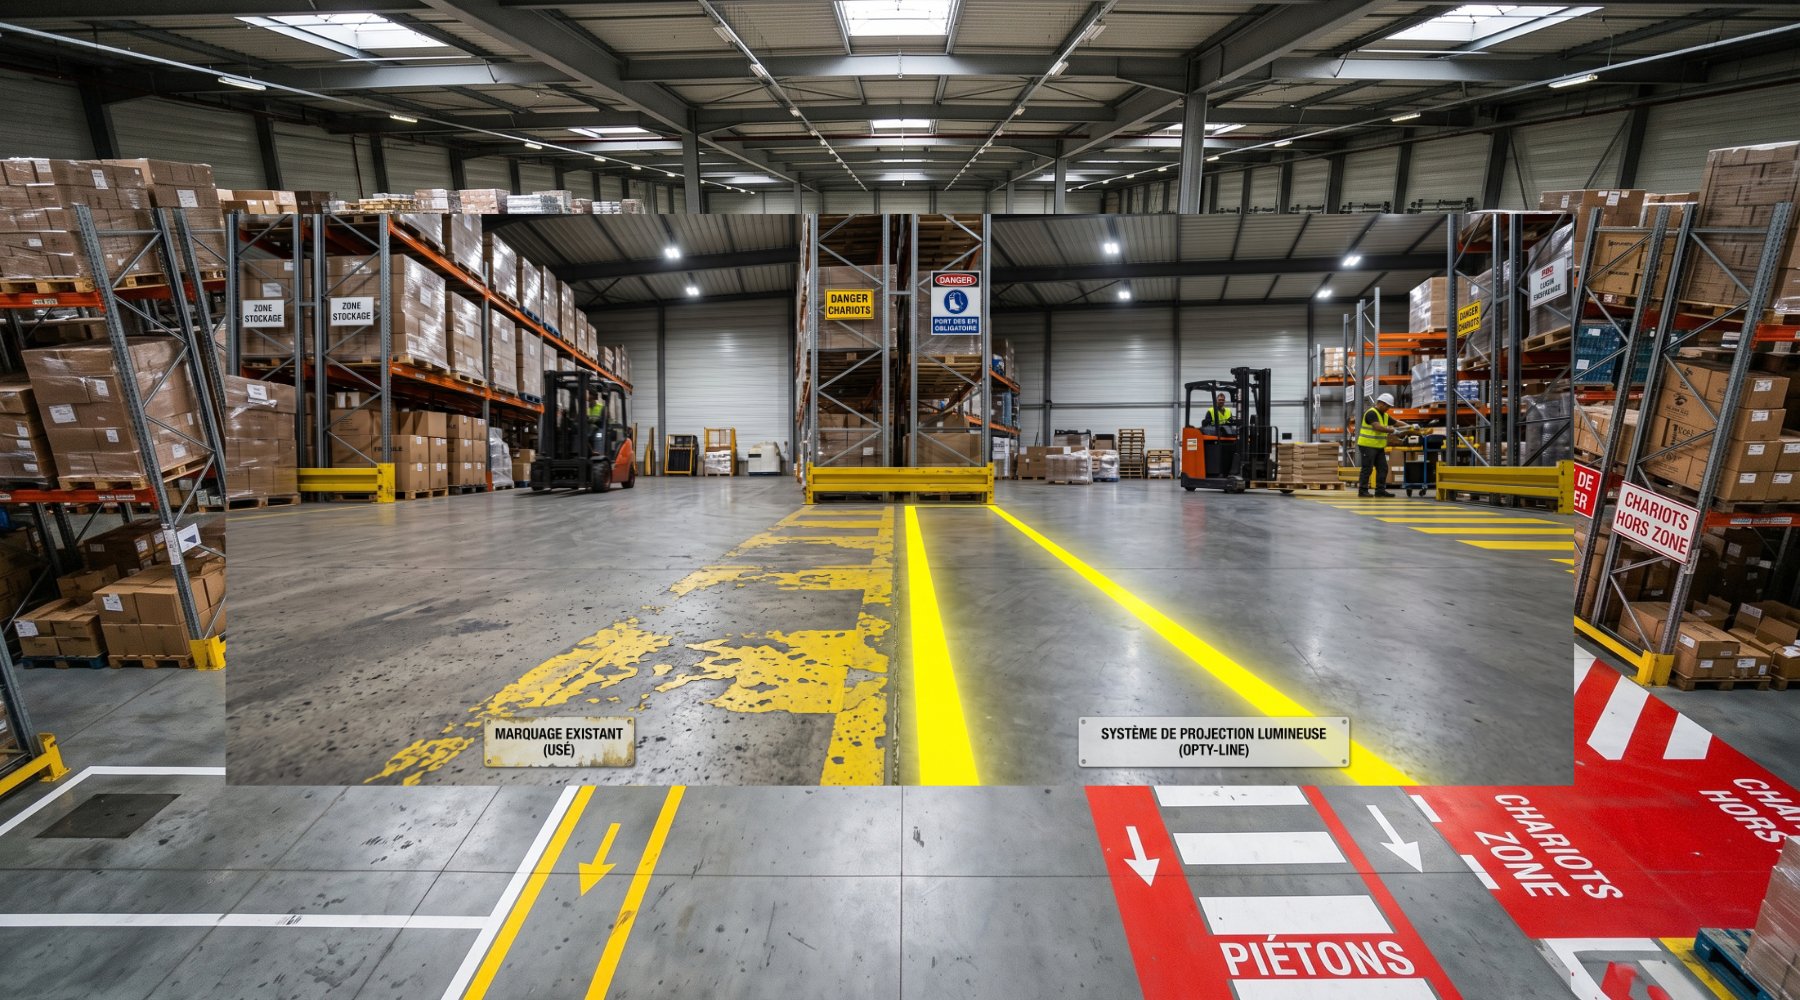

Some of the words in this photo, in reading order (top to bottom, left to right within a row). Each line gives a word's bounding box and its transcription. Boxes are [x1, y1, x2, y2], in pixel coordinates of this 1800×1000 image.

[939, 276, 973, 284] DANGER
[342, 302, 361, 310] ZONE
[831, 294, 868, 303] DANGER
[254, 304, 273, 312] ZONE
[828, 305, 871, 315] CHARIOTS
[244, 314, 282, 323] STOCKAGE
[332, 312, 371, 321] STOCKAGE
[1577, 471, 1594, 491] DE
[1625, 491, 1689, 531] CHARIOTS
[1616, 510, 1649, 537] HORS
[1652, 525, 1689, 555] ZONE
[495, 727, 562, 740] MARQUAGE
[566, 727, 623, 740] EXISTANT
[1101, 725, 1157, 740] SYSTÈME
[1161, 728, 1176, 740] DE
[1180, 727, 1254, 740] PROJECTION
[1258, 727, 1327, 740] LUMINEUSE
[543, 741, 575, 758] (USÉ)
[1179, 743, 1249, 758] (OPTY-LINE)
[1698, 790, 1788, 842] HORS
[1494, 794, 1624, 899] CHARIOTS
[1474, 831, 1571, 897] ZONE
[1219, 934, 1415, 976] PIÉTONS
